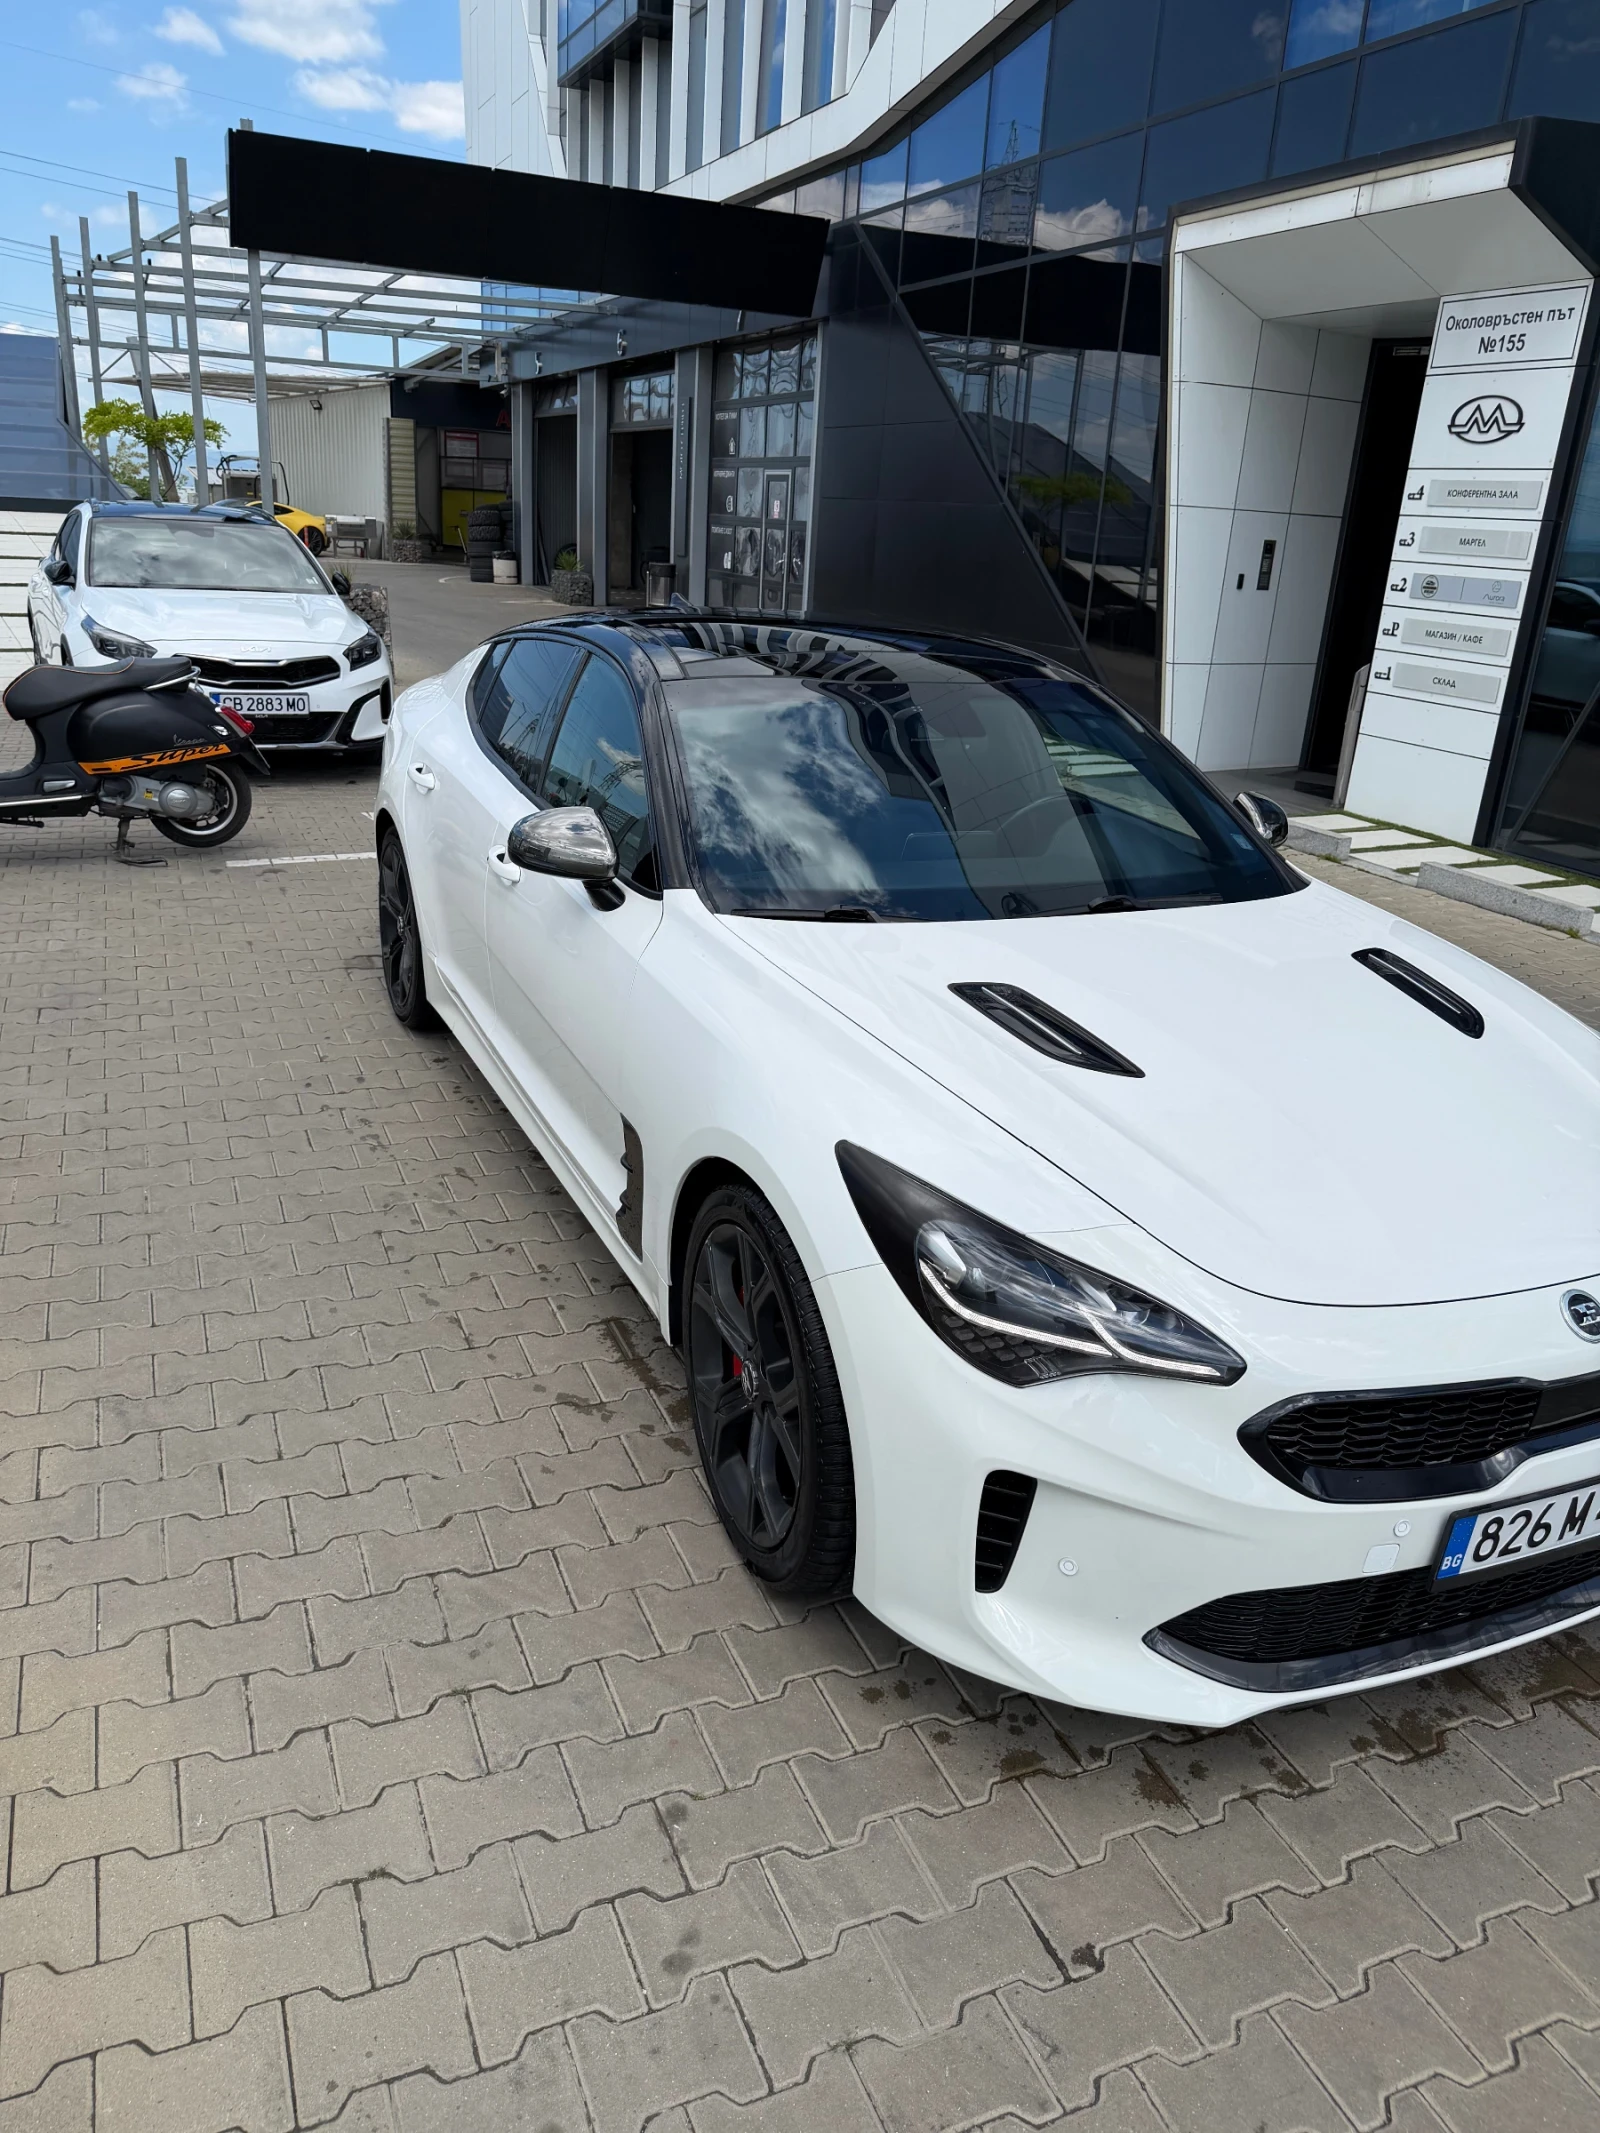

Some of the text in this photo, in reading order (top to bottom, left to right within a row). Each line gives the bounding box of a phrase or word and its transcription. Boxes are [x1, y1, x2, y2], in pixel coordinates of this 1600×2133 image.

[1445, 307, 1576, 331] Околовръстен път
[1477, 333, 1527, 355] №155
[1447, 489, 1497, 499] КОНФЕРЕНТНА
[1498, 490, 1519, 499] ЗАЛА
[1459, 537, 1487, 547] МАРГЕЛ
[1425, 629, 1457, 641] МАГАЗИН
[1462, 634, 1484, 645] КАФЕ
[1432, 676, 1457, 688] СКЛАД
[246, 697, 283, 712] 2883
[286, 697, 306, 712] MO
[120, 743, 224, 770] Super
[1472, 1491, 1600, 1563] 826 M
[1441, 1553, 1463, 1570] BG
